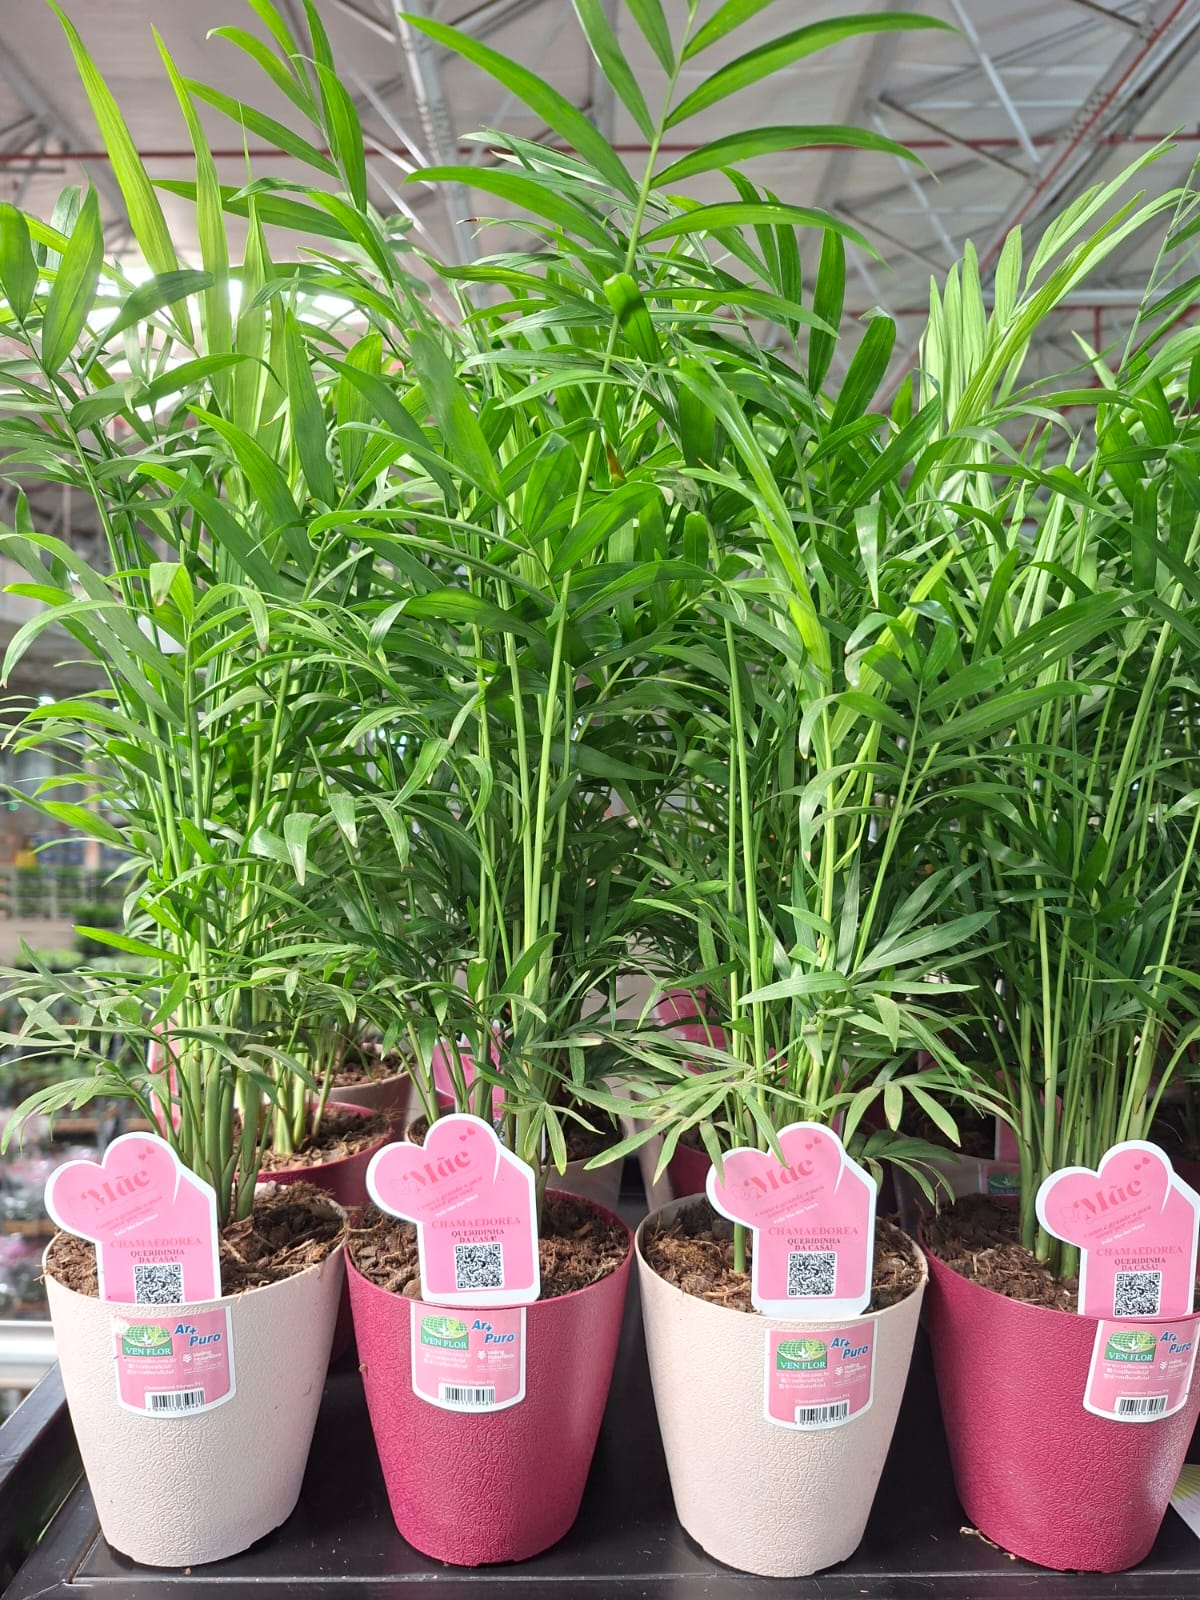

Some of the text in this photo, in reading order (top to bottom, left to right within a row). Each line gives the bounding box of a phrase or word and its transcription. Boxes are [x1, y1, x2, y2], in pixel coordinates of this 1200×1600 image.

[403, 1152, 471, 1191] Mãe
[81, 1170, 150, 1210] Mãe
[1073, 1180, 1142, 1219] Mãe
[431, 1216, 520, 1228] CHAMAEDOREA
[451, 1228, 504, 1238] QUERIDINHA
[768, 1226, 859, 1236] CHAMAEDOREA
[110, 1236, 201, 1248] CHAMAEDOREA
[472, 1235, 497, 1243] CASA!
[787, 1237, 841, 1245] QUERIDINHA
[130, 1248, 184, 1258] QUERIDINHA
[1096, 1246, 1183, 1257] CHAMAEDOREA
[1114, 1257, 1166, 1266] QUERIDINHA
[1134, 1263, 1158, 1271] CASA!
[189, 1333, 221, 1347] Puro
[422, 1336, 468, 1350] VEN FLOR
[484, 1332, 516, 1344] Puro
[125, 1346, 172, 1356] VEN FLOR
[842, 1345, 869, 1360] Puro
[1168, 1342, 1192, 1354] Puro
[1107, 1351, 1153, 1361] VEN FLOR
[779, 1360, 827, 1369] VEN FLOR
